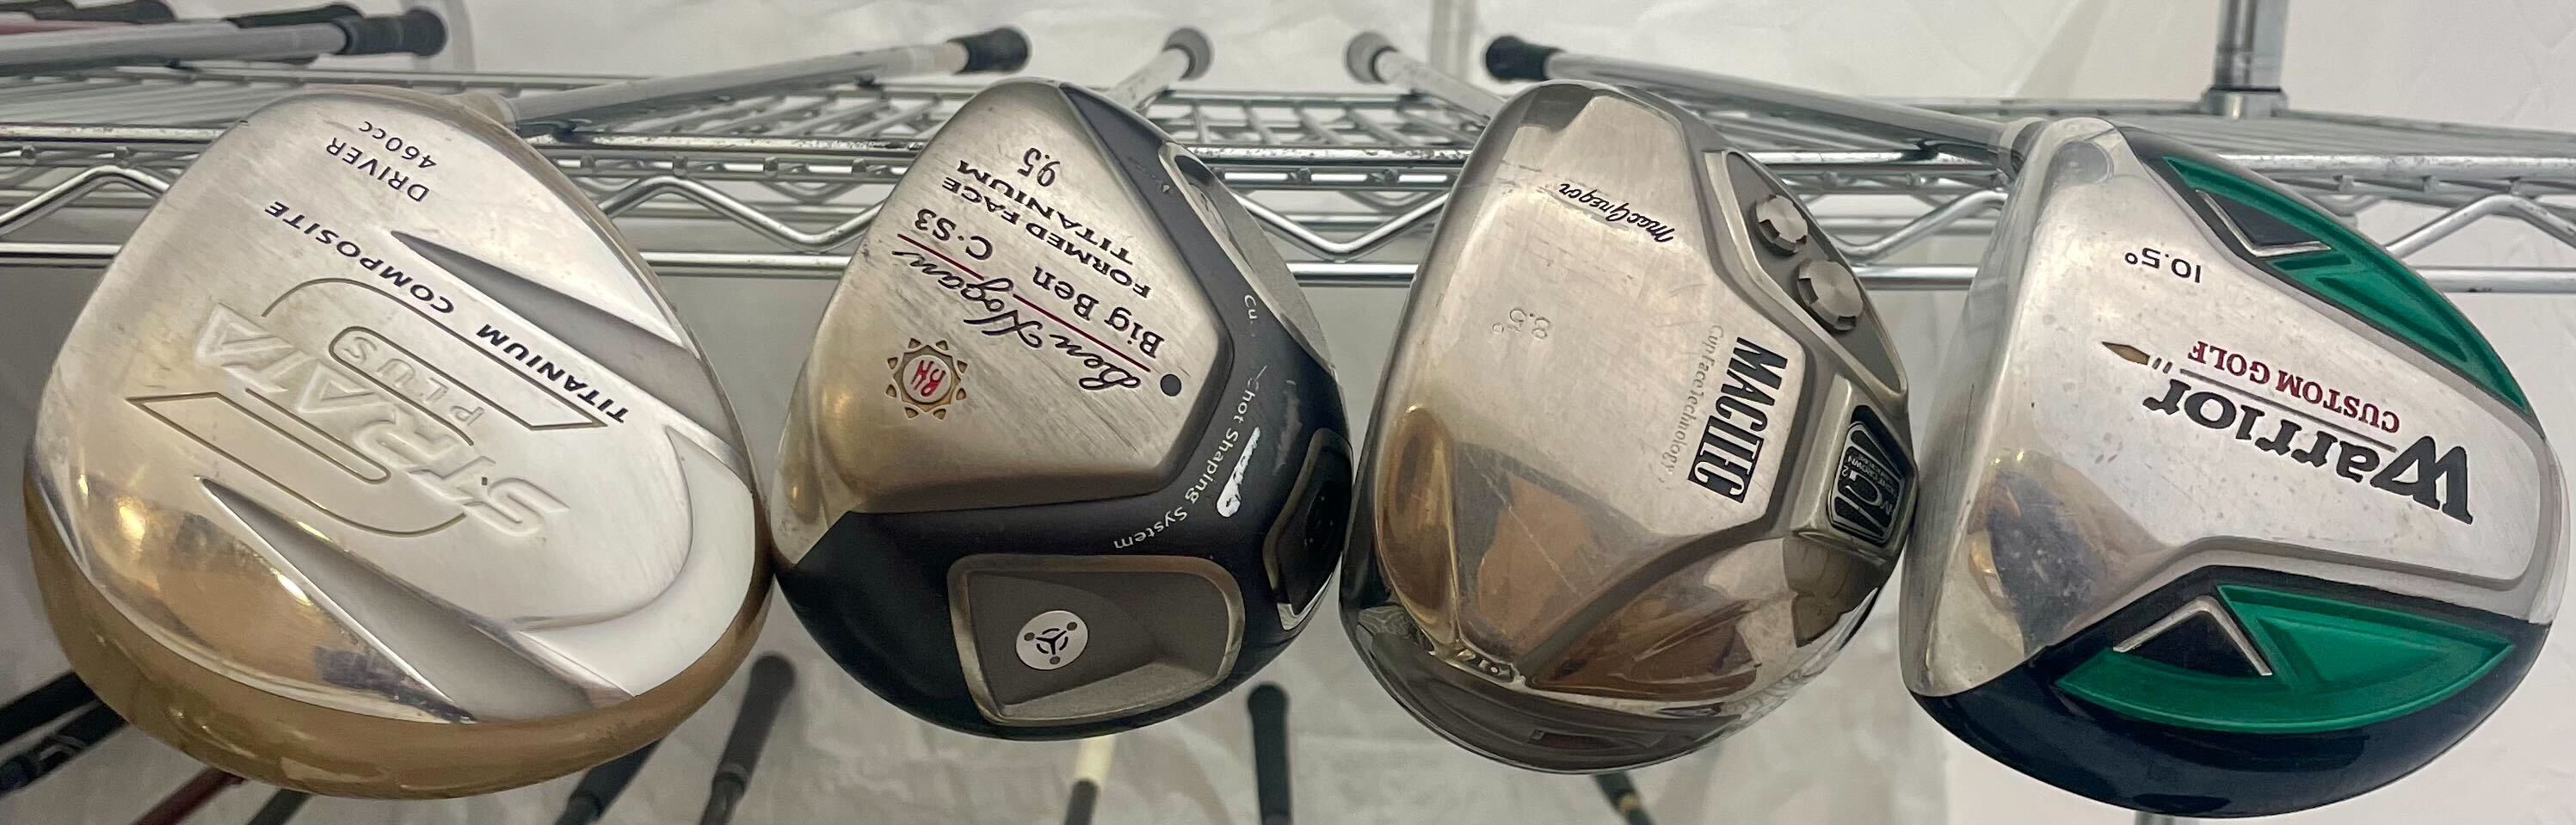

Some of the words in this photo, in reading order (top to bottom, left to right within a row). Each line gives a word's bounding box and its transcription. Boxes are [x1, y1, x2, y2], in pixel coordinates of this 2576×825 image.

[325, 137, 430, 202] DRIVER
[359, 120, 437, 169] 460cc
[1017, 147, 1060, 188] 9.5
[941, 175, 1021, 225] FACE
[956, 159, 1134, 266] TITANIUM
[1558, 182, 1675, 243] MacGregor
[264, 200, 455, 314] COMPOSITE
[1025, 221, 1152, 299] FORMED
[891, 249, 1044, 349] Hogan
[1031, 264, 1100, 322] Ben
[1049, 333, 1142, 391] Ben
[1103, 305, 1166, 360] Big
[2187, 341, 2271, 385] GOLF
[343, 336, 486, 428] PLUS
[475, 323, 629, 424] TITANIUM
[2277, 368, 2400, 434] CUSTOM
[194, 303, 570, 537] STRATA
[1687, 336, 1788, 504] MACTEC
[2142, 378, 2474, 526] Warrior
[1184, 427, 1240, 505] Shaping
[1113, 506, 1188, 550] System
